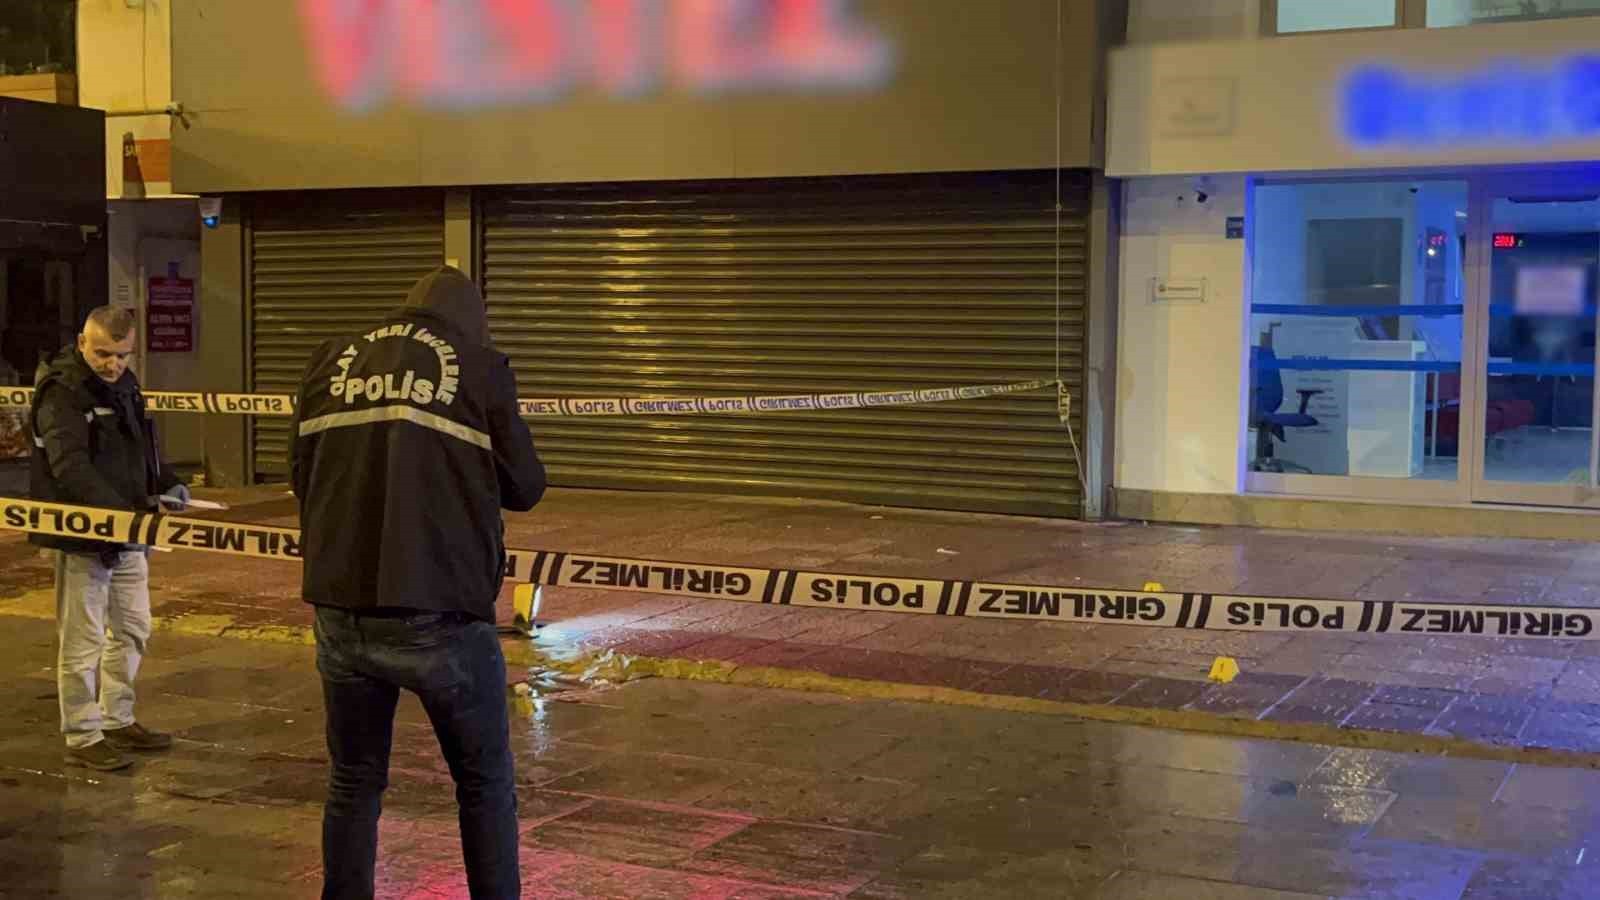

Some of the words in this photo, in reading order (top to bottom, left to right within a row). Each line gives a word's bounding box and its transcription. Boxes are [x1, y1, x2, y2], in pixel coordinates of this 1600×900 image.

[344, 369, 434, 404] POLİS
[5, 504, 115, 538] POLİS
[168, 521, 303, 558] RİLMEZ
[810, 577, 924, 608] POLİS
[1227, 602, 1345, 630] POLİS
